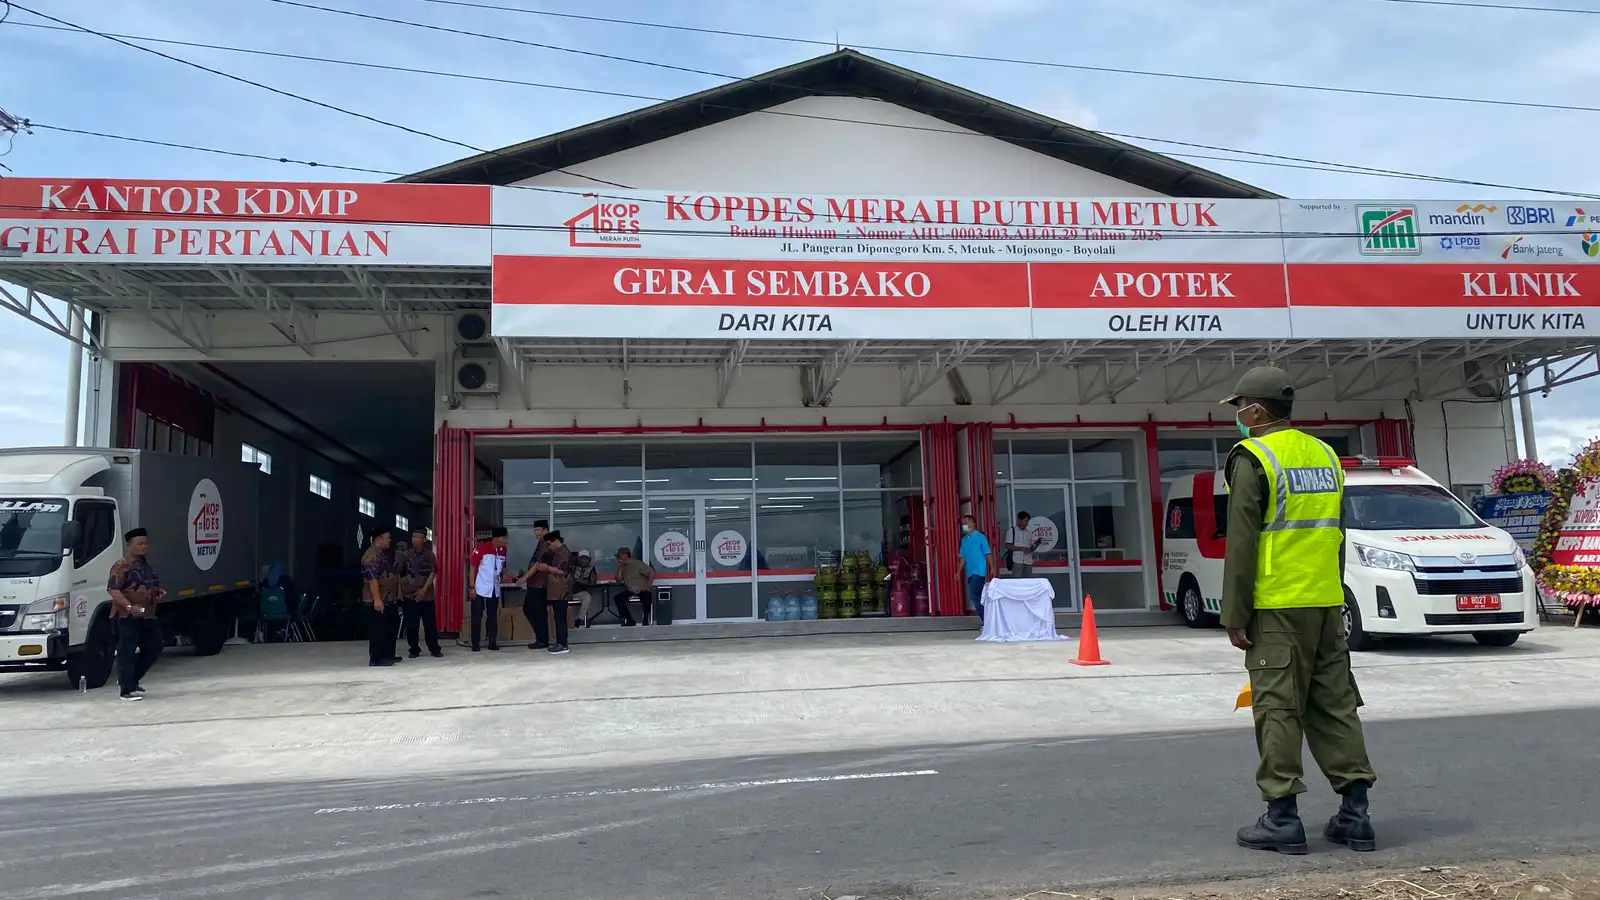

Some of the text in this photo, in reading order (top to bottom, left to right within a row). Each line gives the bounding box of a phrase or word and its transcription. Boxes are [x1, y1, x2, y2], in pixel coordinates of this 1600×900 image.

[40, 184, 358, 216] KANTOR KDMP
[1299, 203, 1332, 211] Supported
[601, 203, 640, 218] KOP
[664, 195, 1220, 227] KOPDES MERAH PUTIH METUK
[1526, 207, 1555, 224] BRI
[1429, 212, 1485, 225] mandiri
[600, 219, 640, 234] DES
[730, 225, 777, 237] Badan
[782, 225, 837, 239] Hukum
[856, 226, 906, 240] Nomor
[1083, 228, 1126, 240] Tahun
[0, 226, 391, 256] GERAI PERTANIAN
[1455, 237, 1480, 246] LPDB
[1512, 244, 1534, 253] Bank
[781, 243, 798, 252] JL.
[802, 243, 853, 255] Pangeran
[857, 244, 919, 256] Diponegoro
[922, 244, 944, 254] Km.
[961, 245, 995, 254] Metuk
[1005, 245, 1063, 257] Mojosongo
[1073, 246, 1115, 257] Boyolali
[613, 267, 931, 298] GERAI SEMBAKO
[1089, 272, 1236, 298] APOTEK
[1460, 272, 1582, 297] KLINIK
[718, 313, 833, 332] DARI KITA
[1108, 314, 1223, 332] OLEH KITA
[1466, 313, 1586, 330] UNTUK KITA
[206, 503, 220, 516] KOP
[205, 518, 220, 530] DES
[197, 546, 217, 556] METUK
